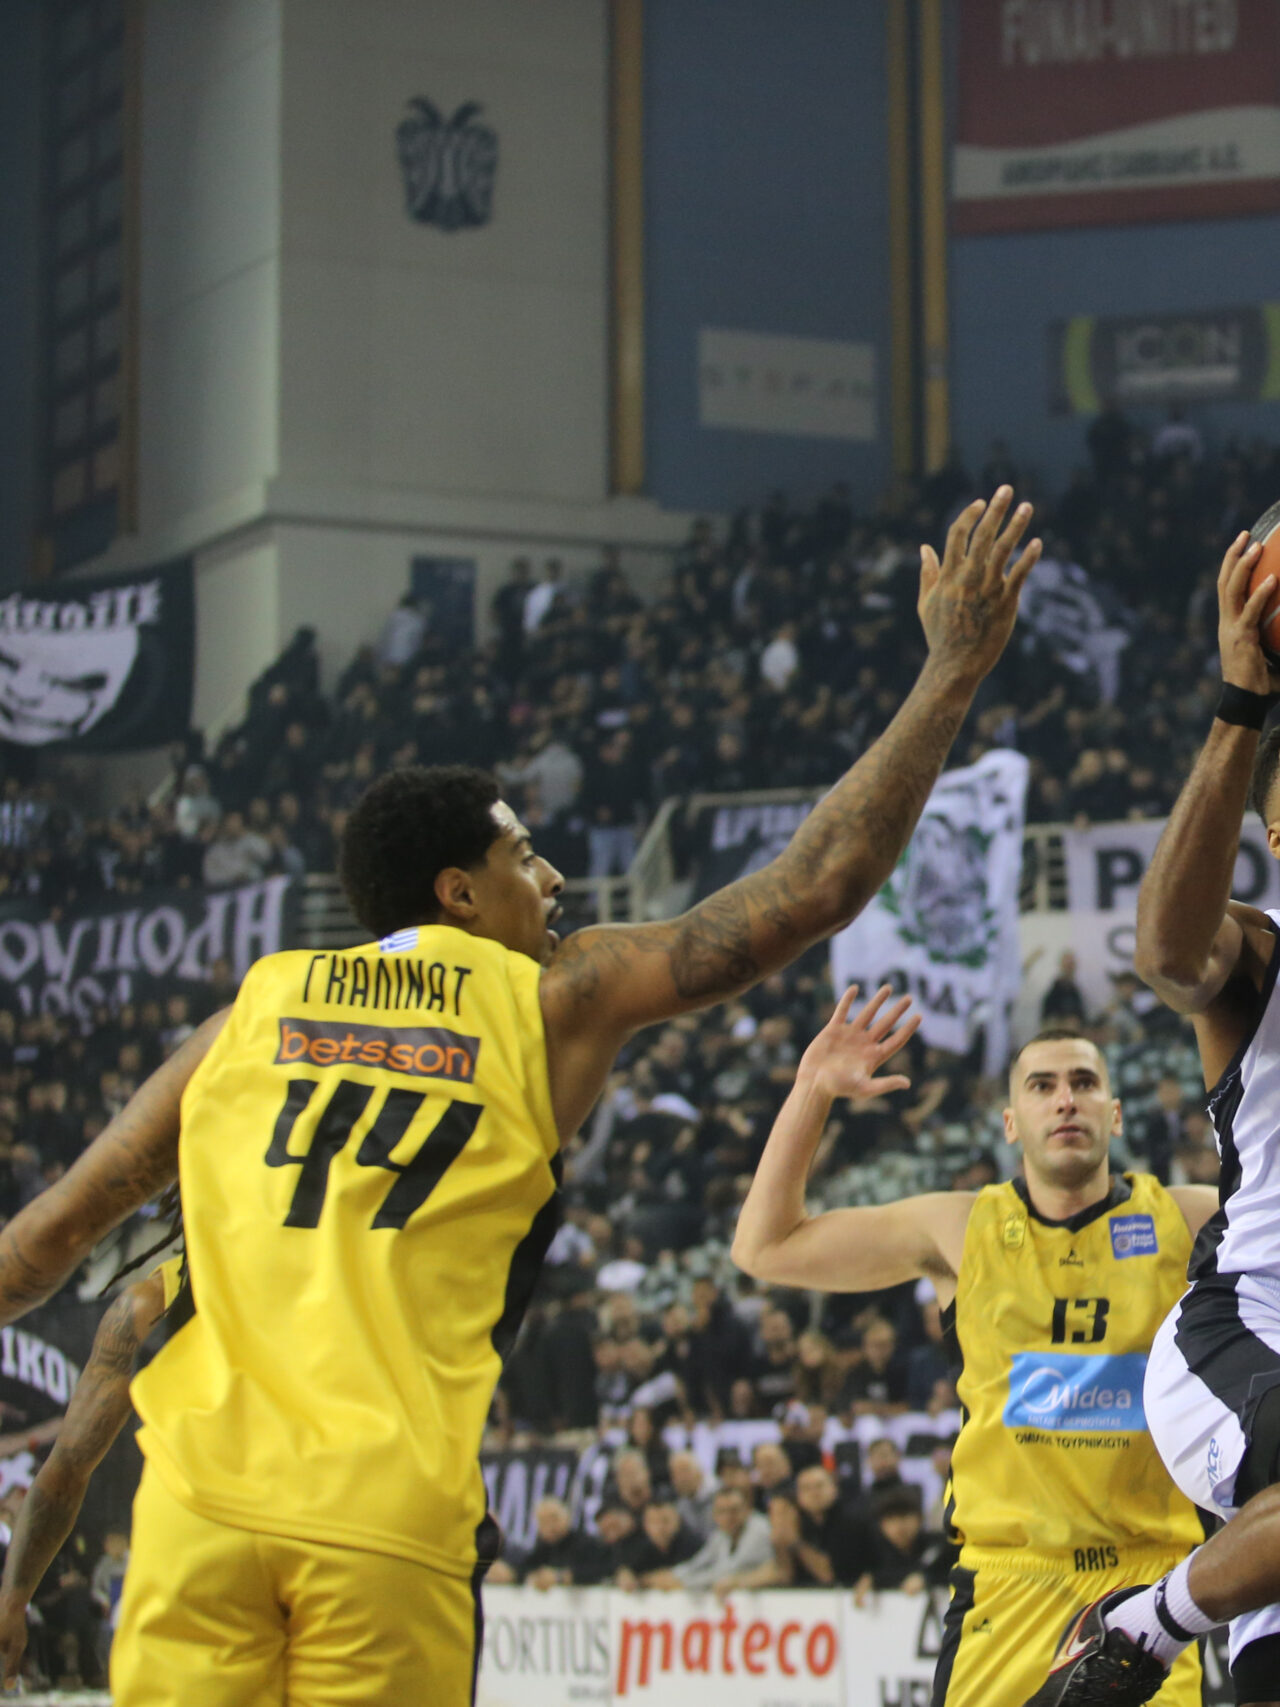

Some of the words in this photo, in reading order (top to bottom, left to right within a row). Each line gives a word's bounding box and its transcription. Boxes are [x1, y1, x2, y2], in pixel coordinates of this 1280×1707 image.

[280, 1025, 471, 1077] betsson
[264, 1078, 485, 1231] 44
[1052, 1297, 1110, 1344] 13
[1040, 1380, 1132, 1412] Midea
[1074, 1545, 1119, 1572] ARIS
[616, 1603, 840, 1696] mateco
